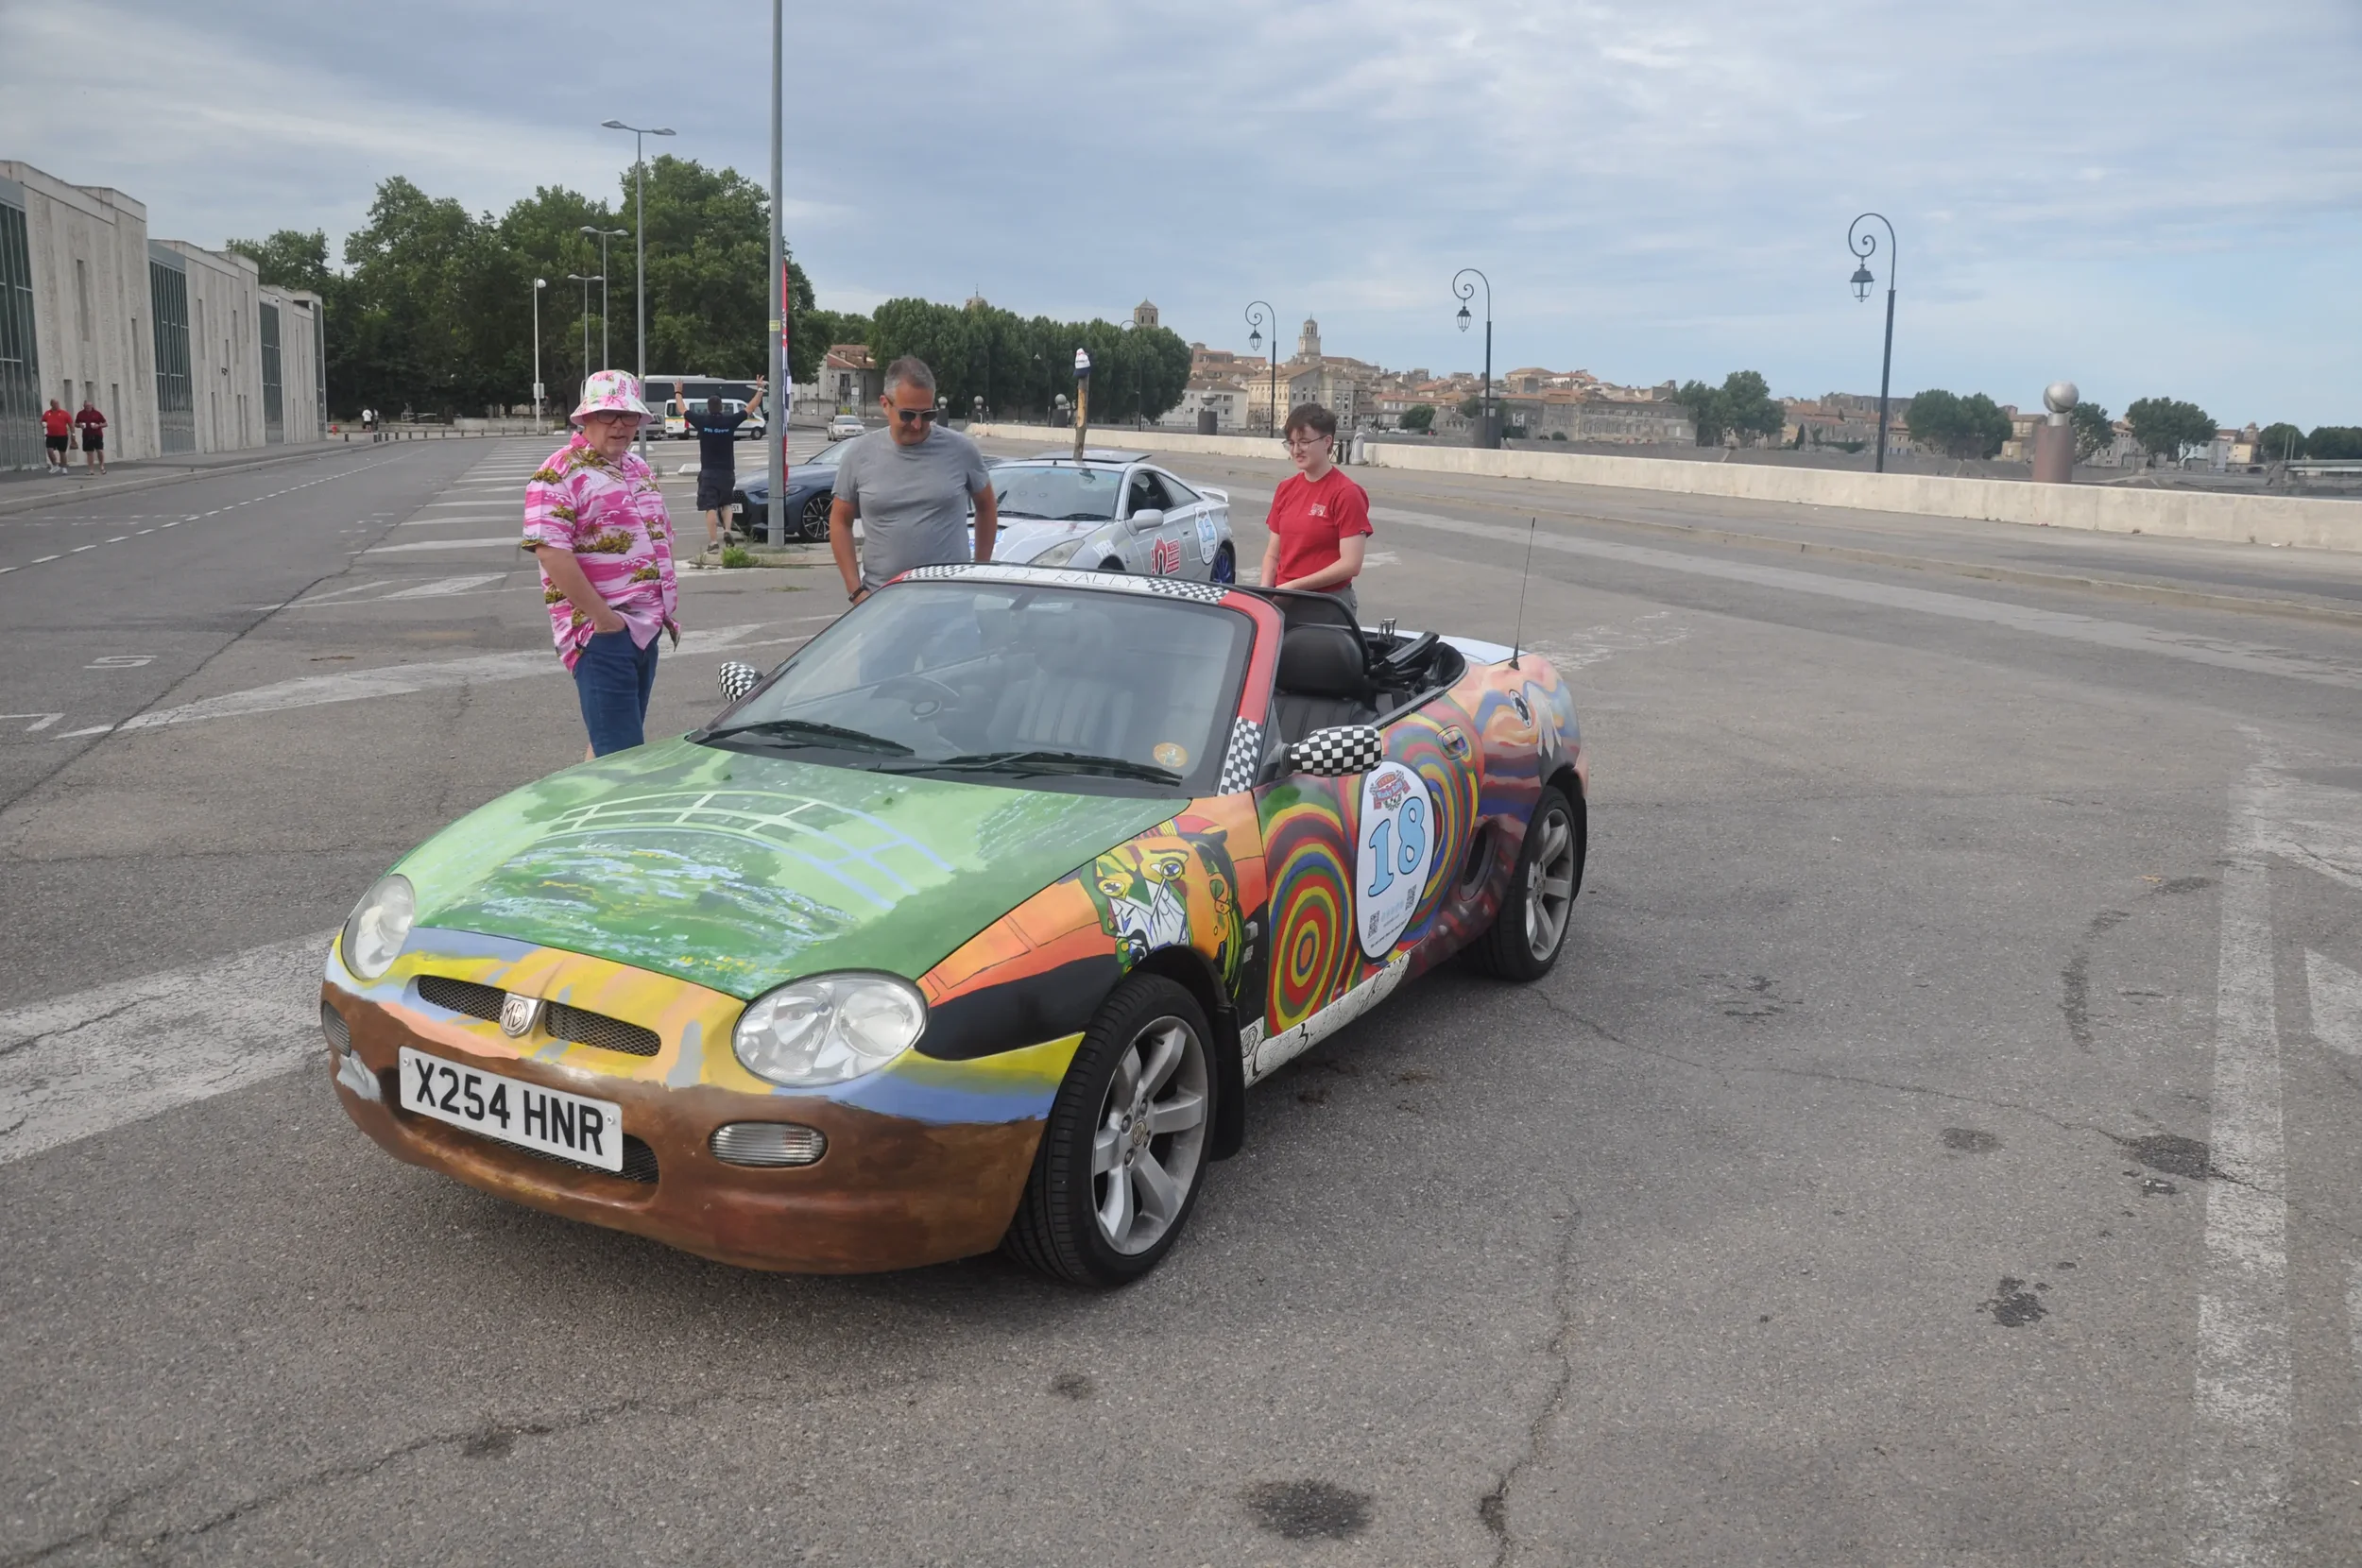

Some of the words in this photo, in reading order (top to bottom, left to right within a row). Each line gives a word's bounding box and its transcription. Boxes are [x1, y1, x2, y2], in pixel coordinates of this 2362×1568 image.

[1054, 571, 1142, 587] RALLY
[1368, 796, 1426, 897] 18
[504, 1003, 524, 1028] MG
[414, 1057, 511, 1130] X254
[523, 1089, 604, 1156] HNR
